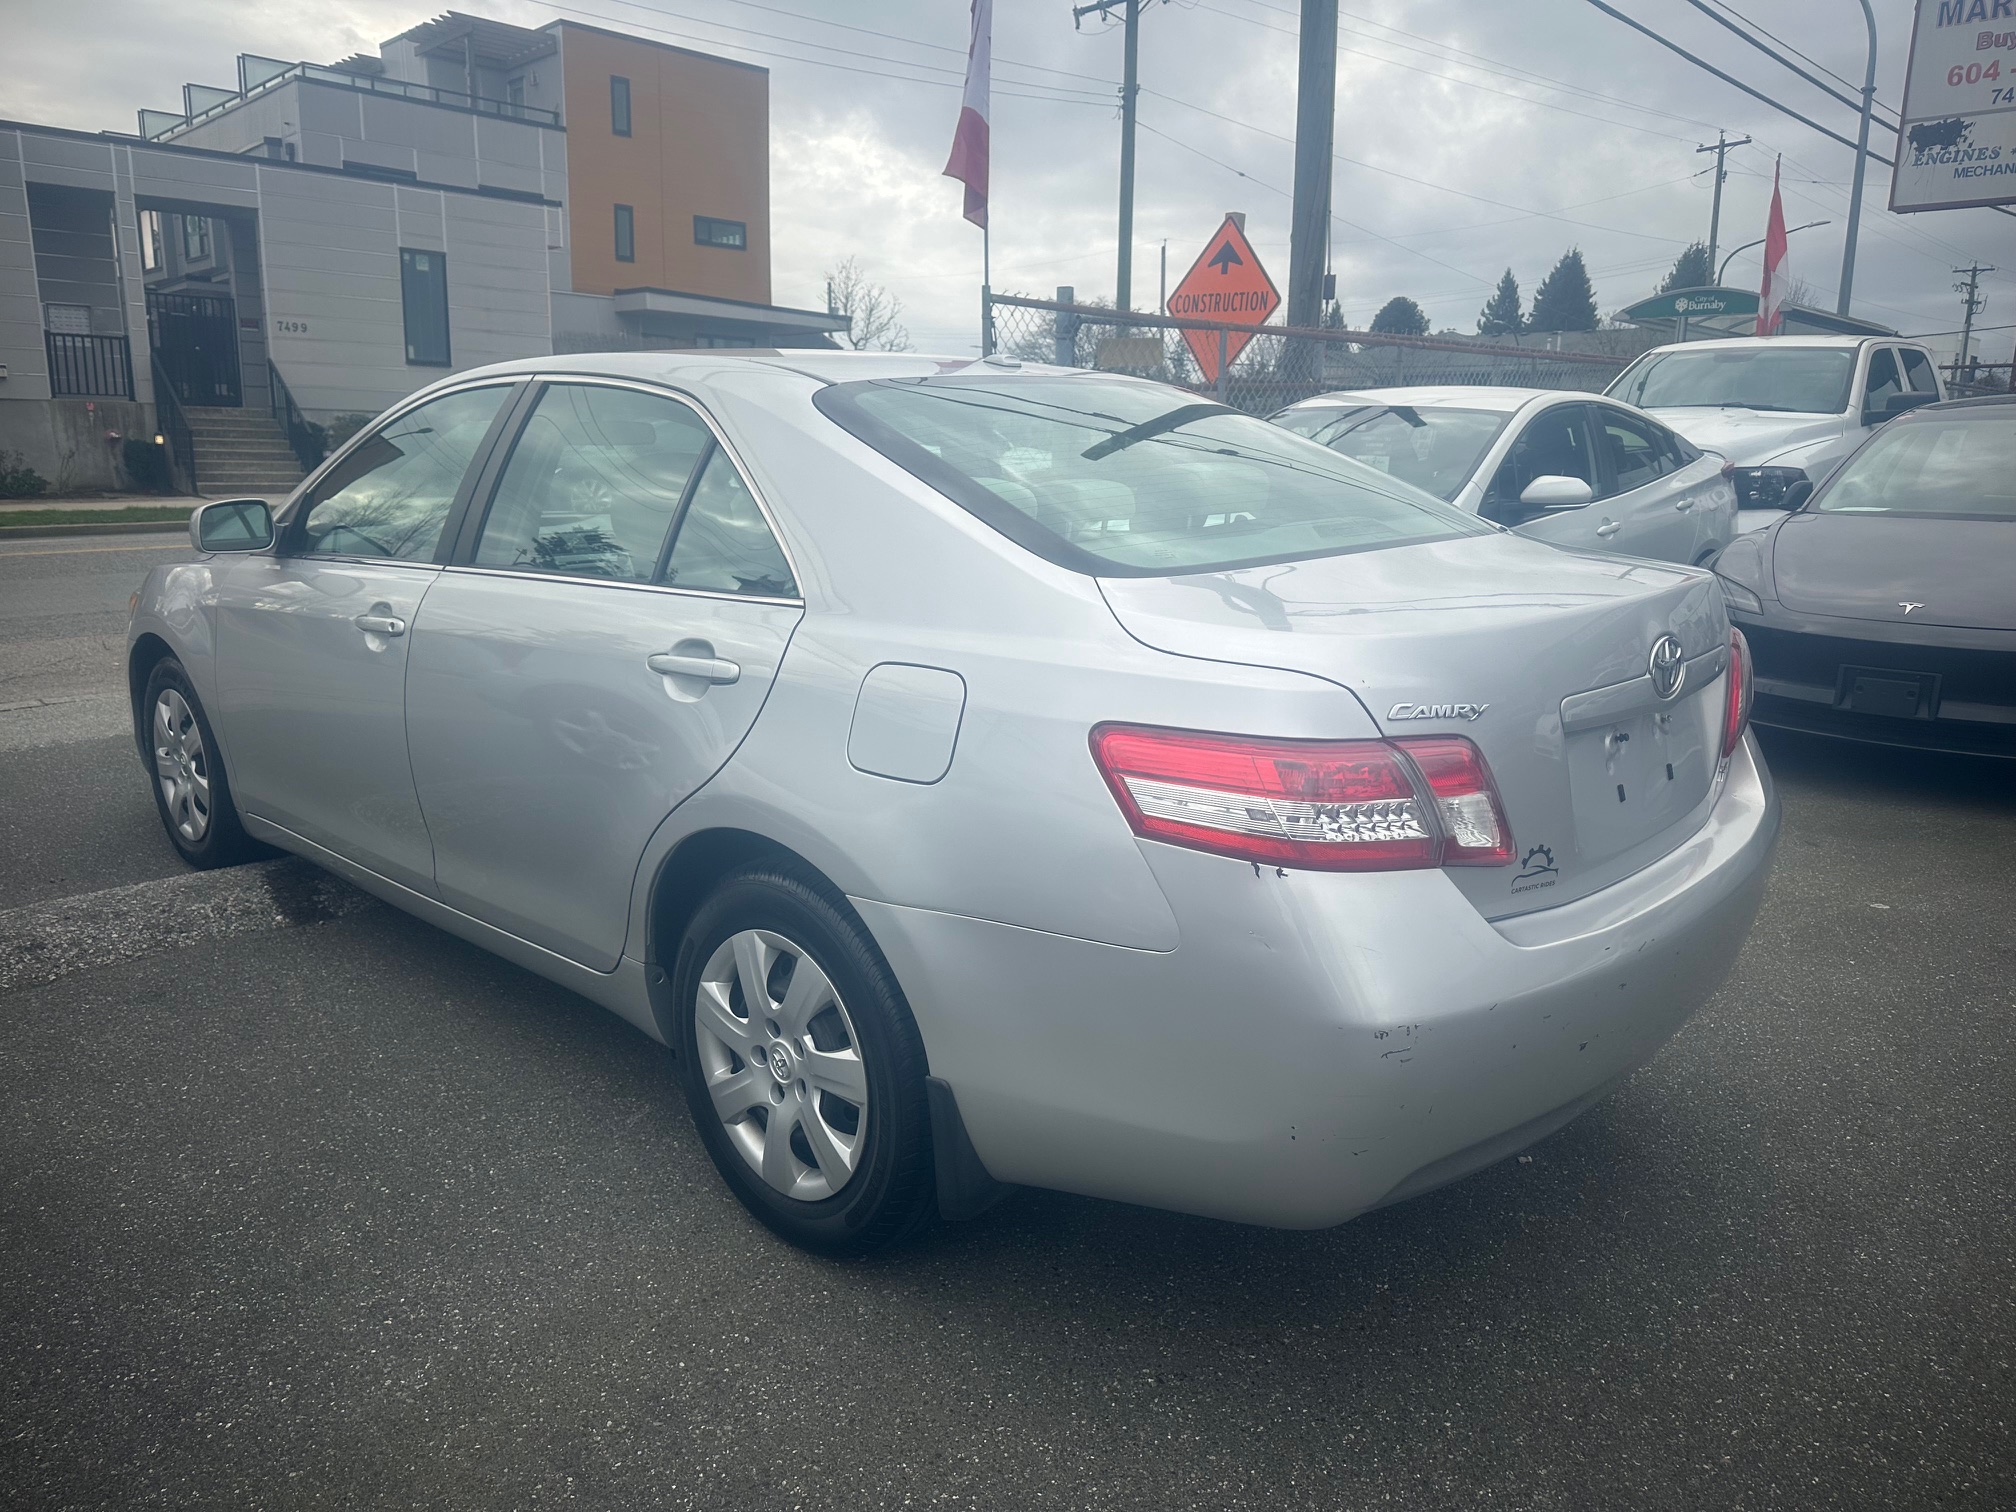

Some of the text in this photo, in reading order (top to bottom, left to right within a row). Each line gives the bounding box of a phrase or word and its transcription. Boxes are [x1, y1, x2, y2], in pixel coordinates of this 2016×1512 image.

[1947, 60, 2000, 86] 604
[1912, 146, 2001, 167] ENGINES
[1175, 291, 1269, 313] CONSTRUCTION
[1688, 299, 1726, 311] Burnaby
[277, 320, 307, 333] 7499
[1387, 703, 1490, 721] CAMRY
[1511, 880, 1556, 894] CARTASTIC RIDES
